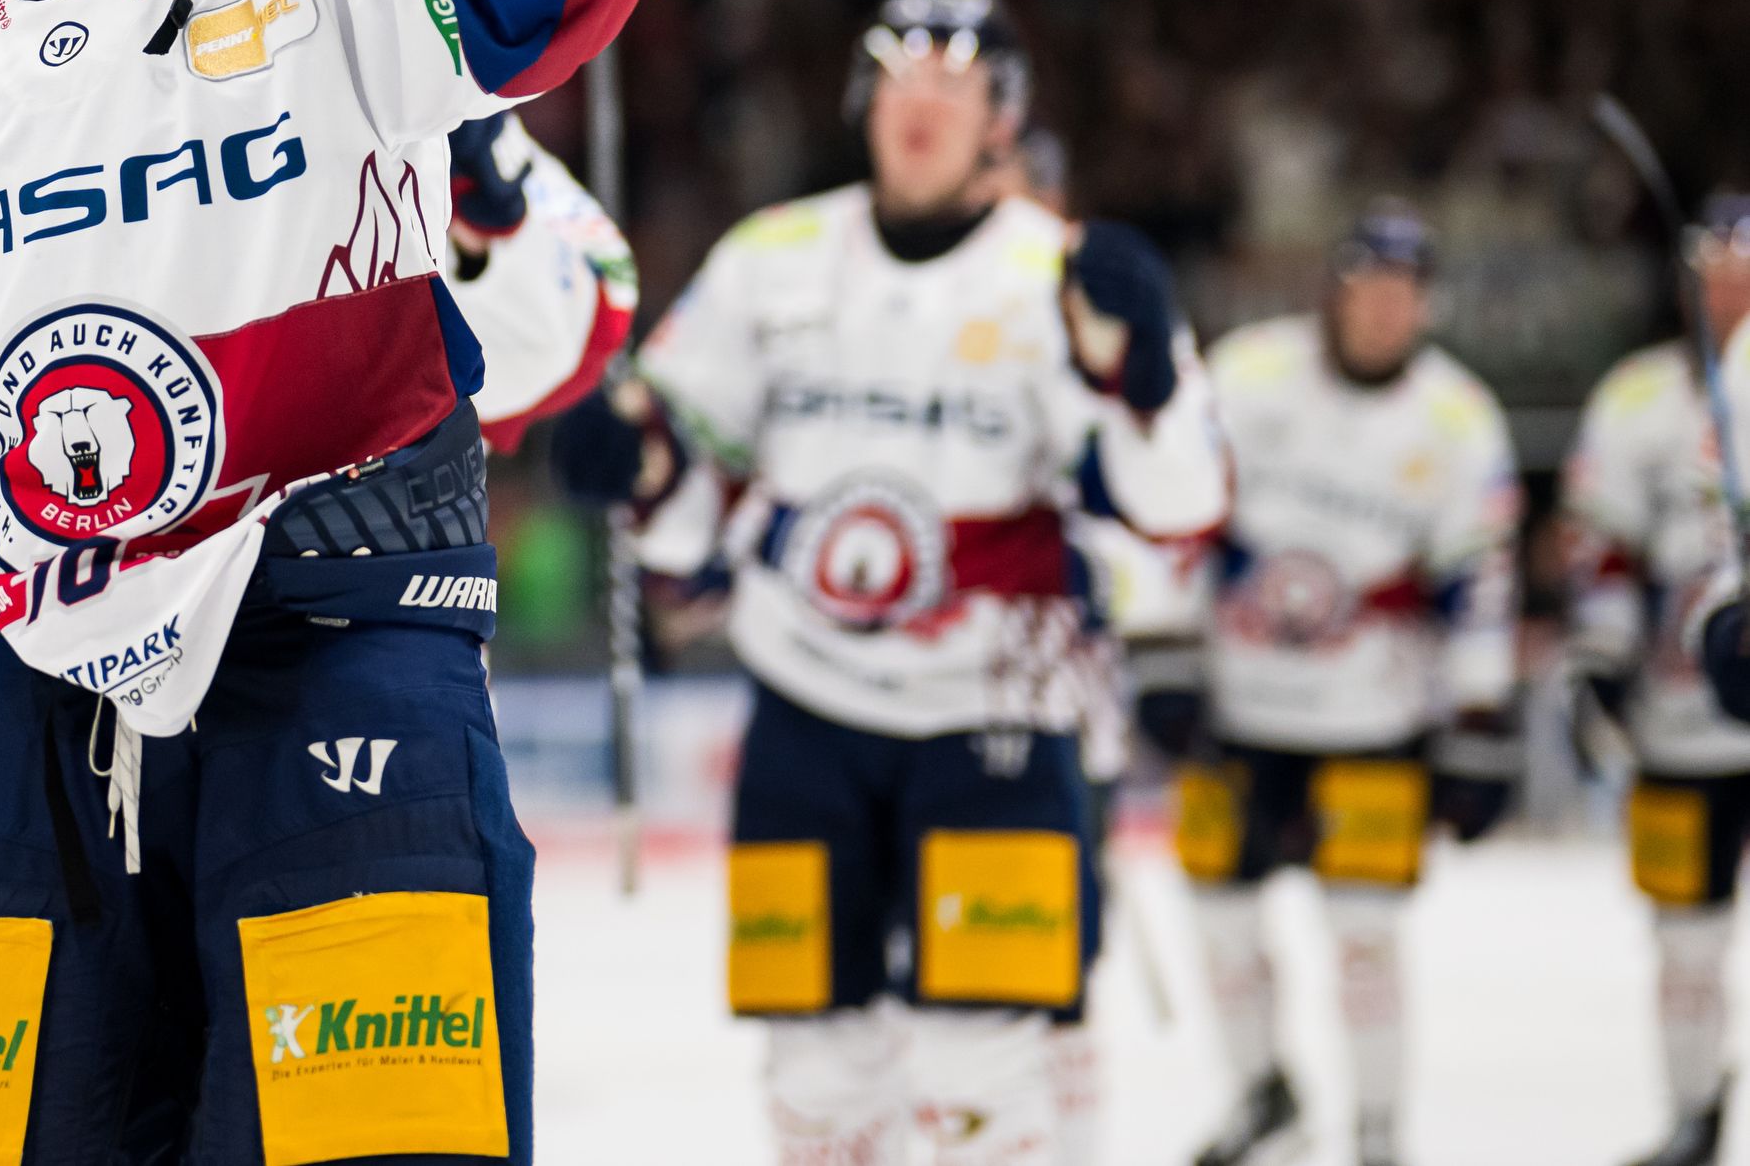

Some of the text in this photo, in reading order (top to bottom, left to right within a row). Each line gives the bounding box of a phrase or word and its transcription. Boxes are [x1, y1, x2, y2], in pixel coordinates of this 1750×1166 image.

[195, 27, 255, 56] PENNY
[50, 323, 138, 356] AUCH
[147, 353, 205, 515] KÜNFTIG
[40, 498, 133, 532] BERLIN
[59, 614, 182, 690] TIPARK
[316, 995, 485, 1055] Knittel
